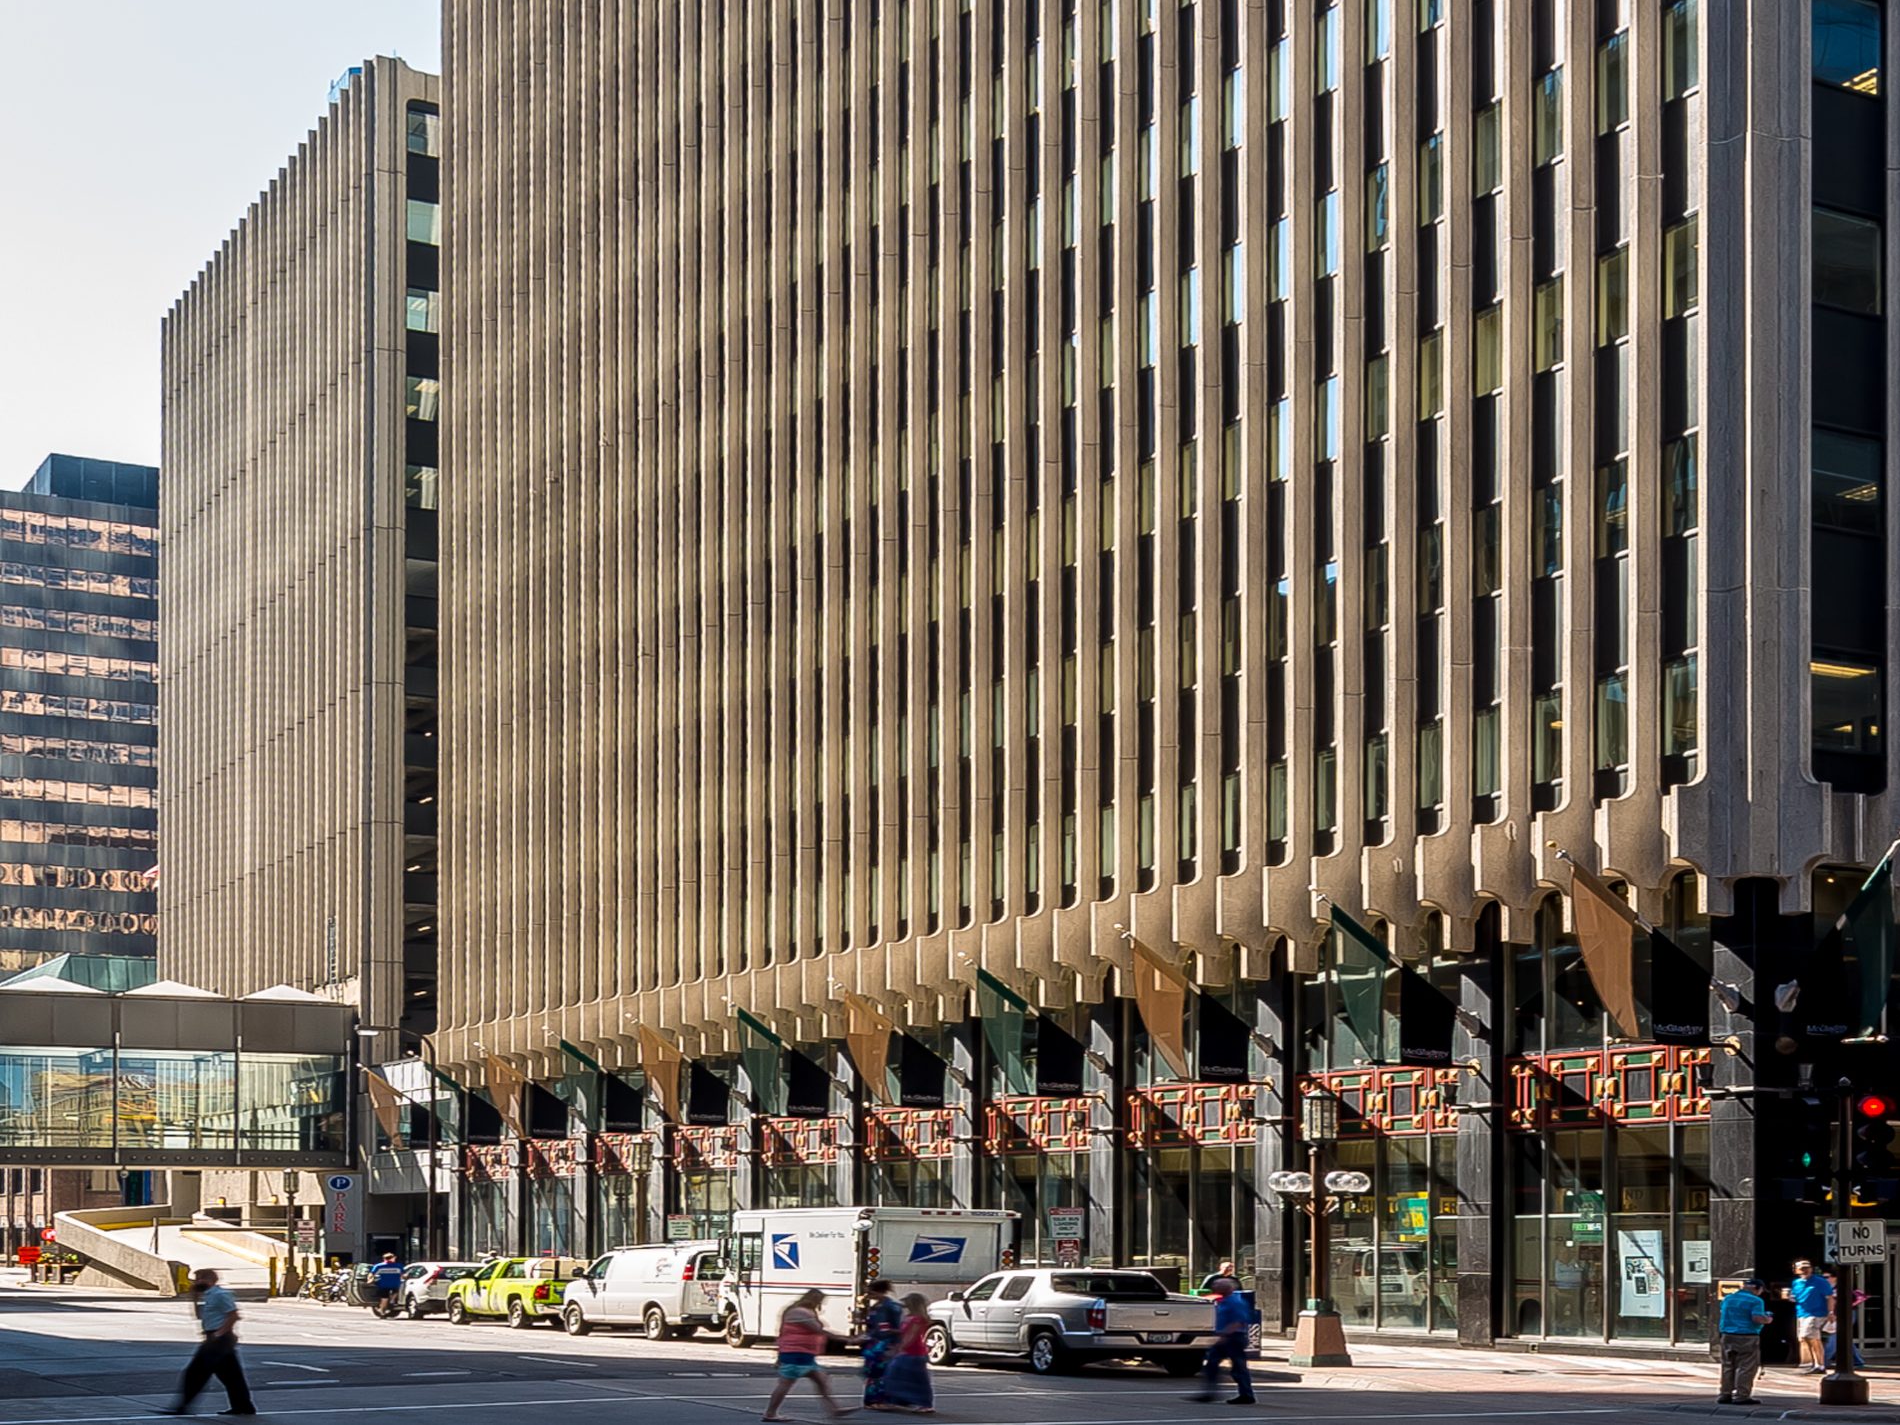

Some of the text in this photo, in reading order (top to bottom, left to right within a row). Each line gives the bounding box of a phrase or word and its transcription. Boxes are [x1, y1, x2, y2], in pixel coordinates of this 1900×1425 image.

[1653, 1023, 1704, 1034] McGladrey
[336, 1177, 348, 1189] P
[333, 1192, 348, 1232] PARK
[1852, 1226, 1870, 1240] NO
[1840, 1244, 1884, 1257] TURNS
[1243, 1323, 1261, 1352] PRESS
